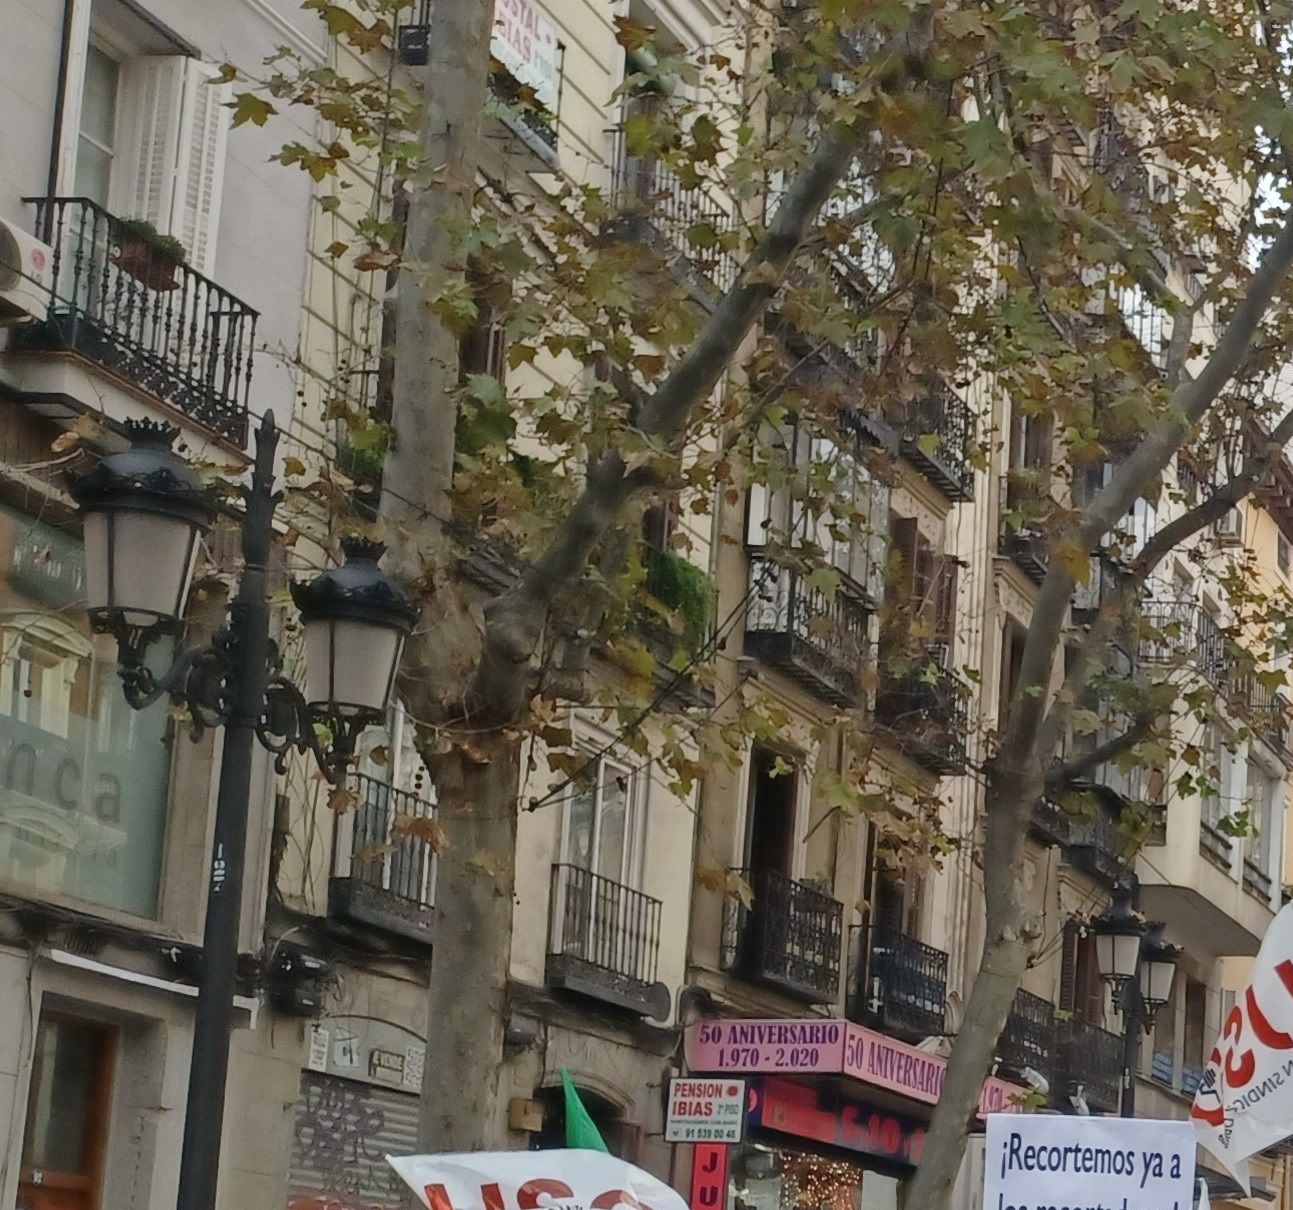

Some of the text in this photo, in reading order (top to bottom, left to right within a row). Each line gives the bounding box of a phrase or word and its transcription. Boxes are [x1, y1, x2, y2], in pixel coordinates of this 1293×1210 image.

[700, 1023, 839, 1044] 50 ANIVERSARIO
[718, 1049, 760, 1067] 1.970
[774, 1047, 819, 1067] 2.020
[674, 1083, 722, 1098] PENSION
[672, 1101, 713, 1116] IBIAS
[1001, 1133, 1181, 1188] ¡Recortemos ya a
